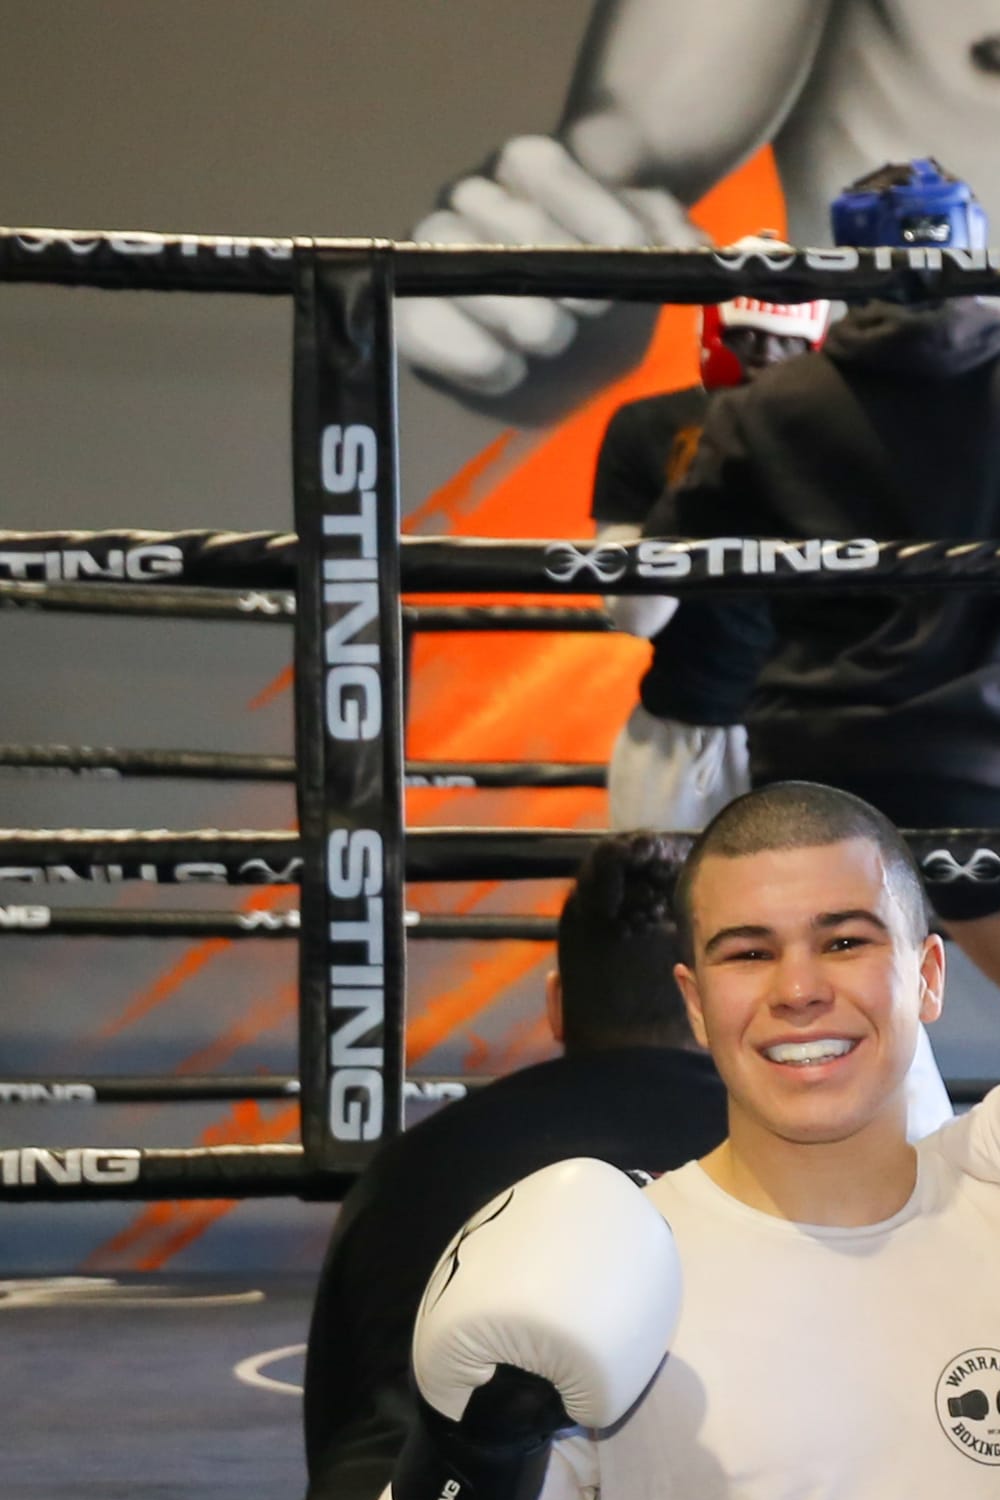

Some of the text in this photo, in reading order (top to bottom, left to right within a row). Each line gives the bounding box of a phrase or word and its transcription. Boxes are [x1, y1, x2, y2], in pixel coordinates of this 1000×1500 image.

[321, 423, 382, 741] STING
[637, 537, 879, 578] STING
[328, 829, 384, 1142] STING
